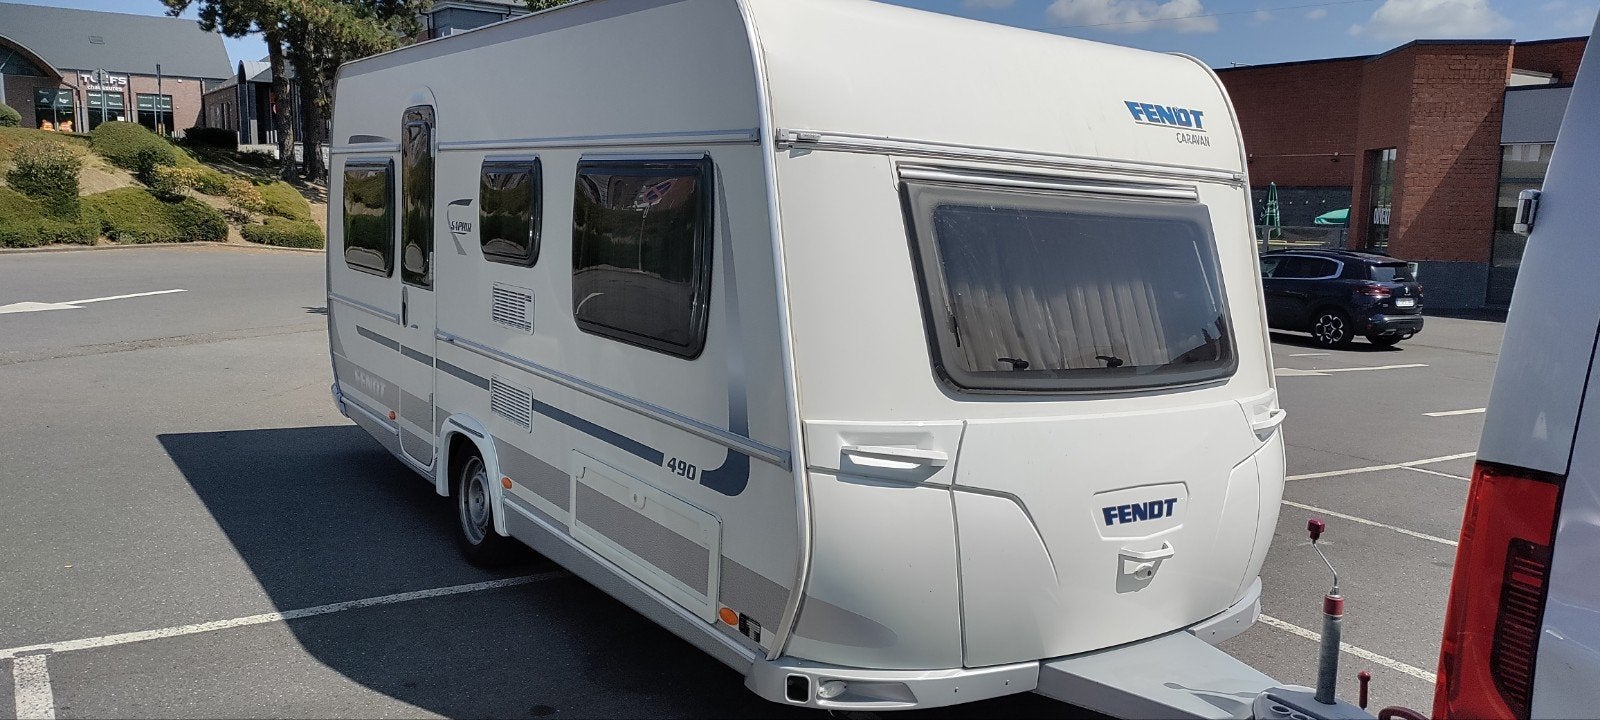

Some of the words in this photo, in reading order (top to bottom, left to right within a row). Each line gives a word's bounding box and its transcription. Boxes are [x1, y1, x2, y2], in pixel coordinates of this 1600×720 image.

[81, 74, 127, 85] TFS
[1123, 100, 1204, 130] FENDT
[1176, 132, 1211, 148] CARAVAN
[667, 457, 697, 481] 490
[1102, 497, 1178, 526] FENDT
